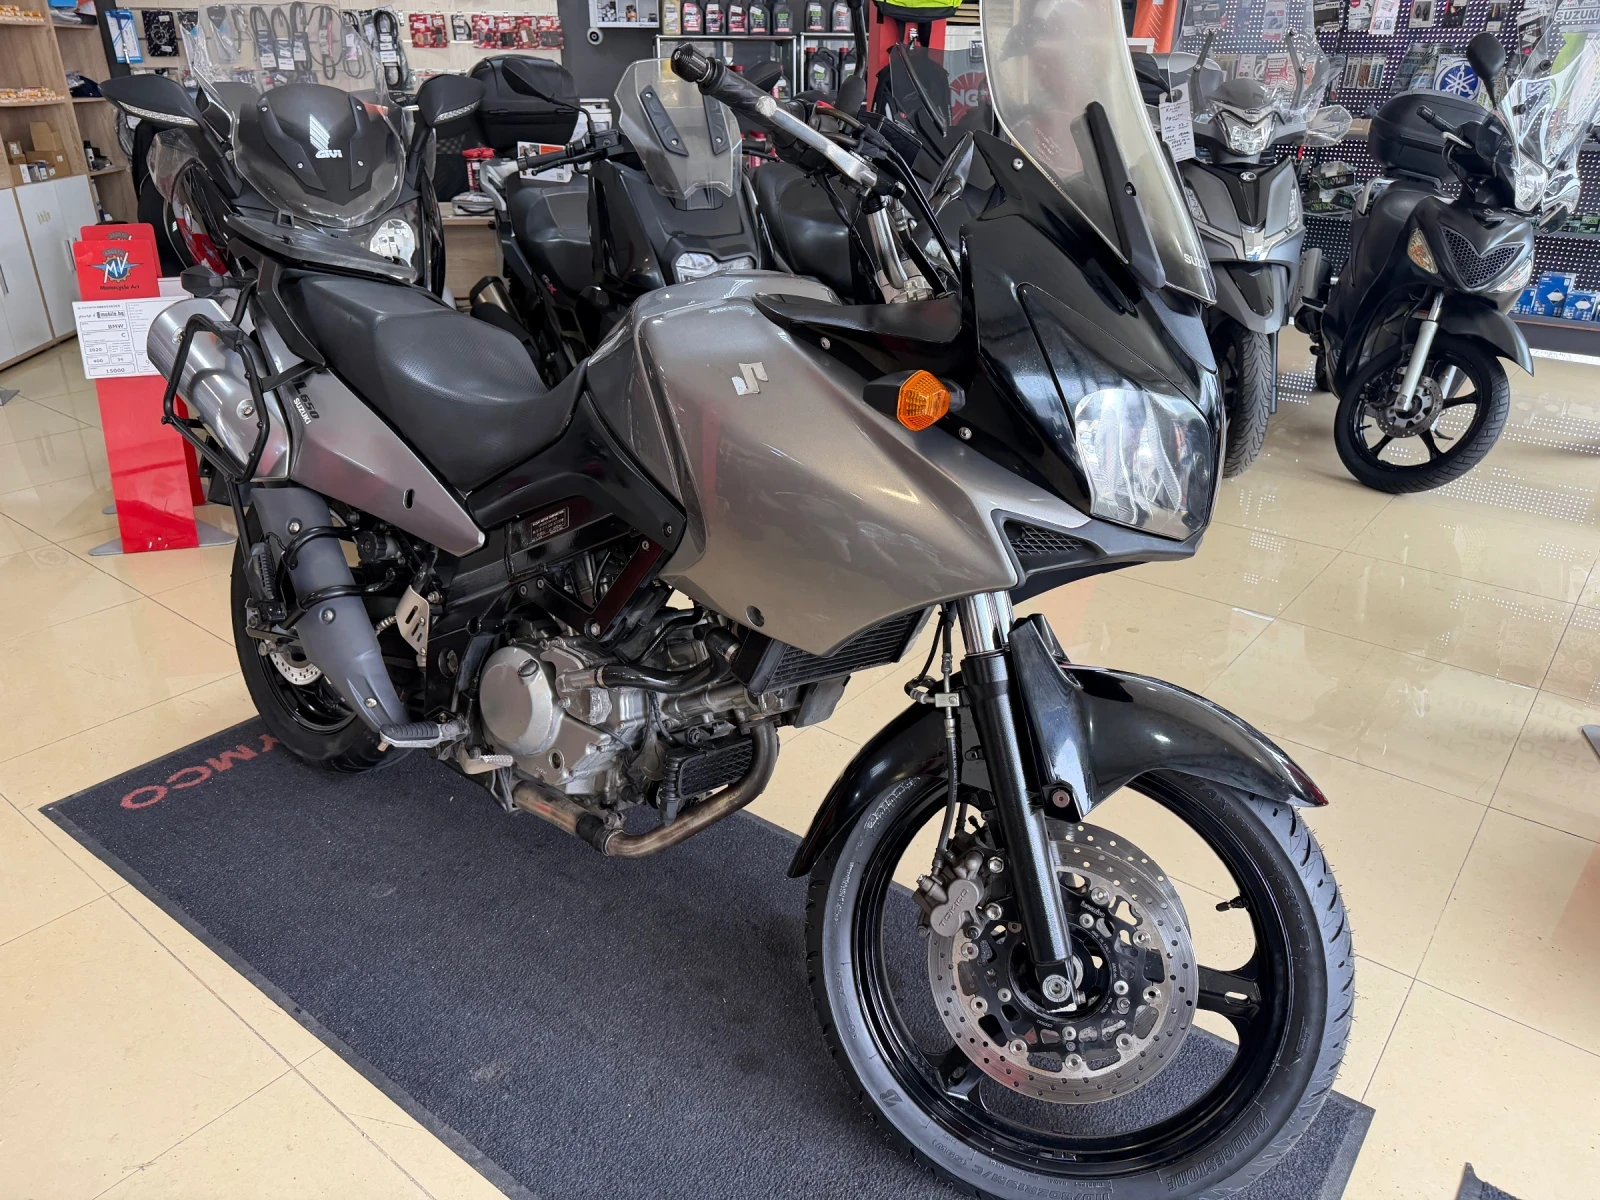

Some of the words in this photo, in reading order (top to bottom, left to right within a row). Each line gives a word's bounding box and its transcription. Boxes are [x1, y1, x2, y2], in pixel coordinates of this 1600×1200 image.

[1555, 9, 1600, 20] SUZUKI
[950, 89, 987, 107] NG
[315, 149, 343, 158] GIVI
[103, 252, 129, 284] MV
[293, 397, 312, 425] SUZUKI
[120, 733, 279, 810] YMCO
[938, 888, 969, 927] TOKICO
[1165, 1110, 1272, 1193] BRIDGESTONE
